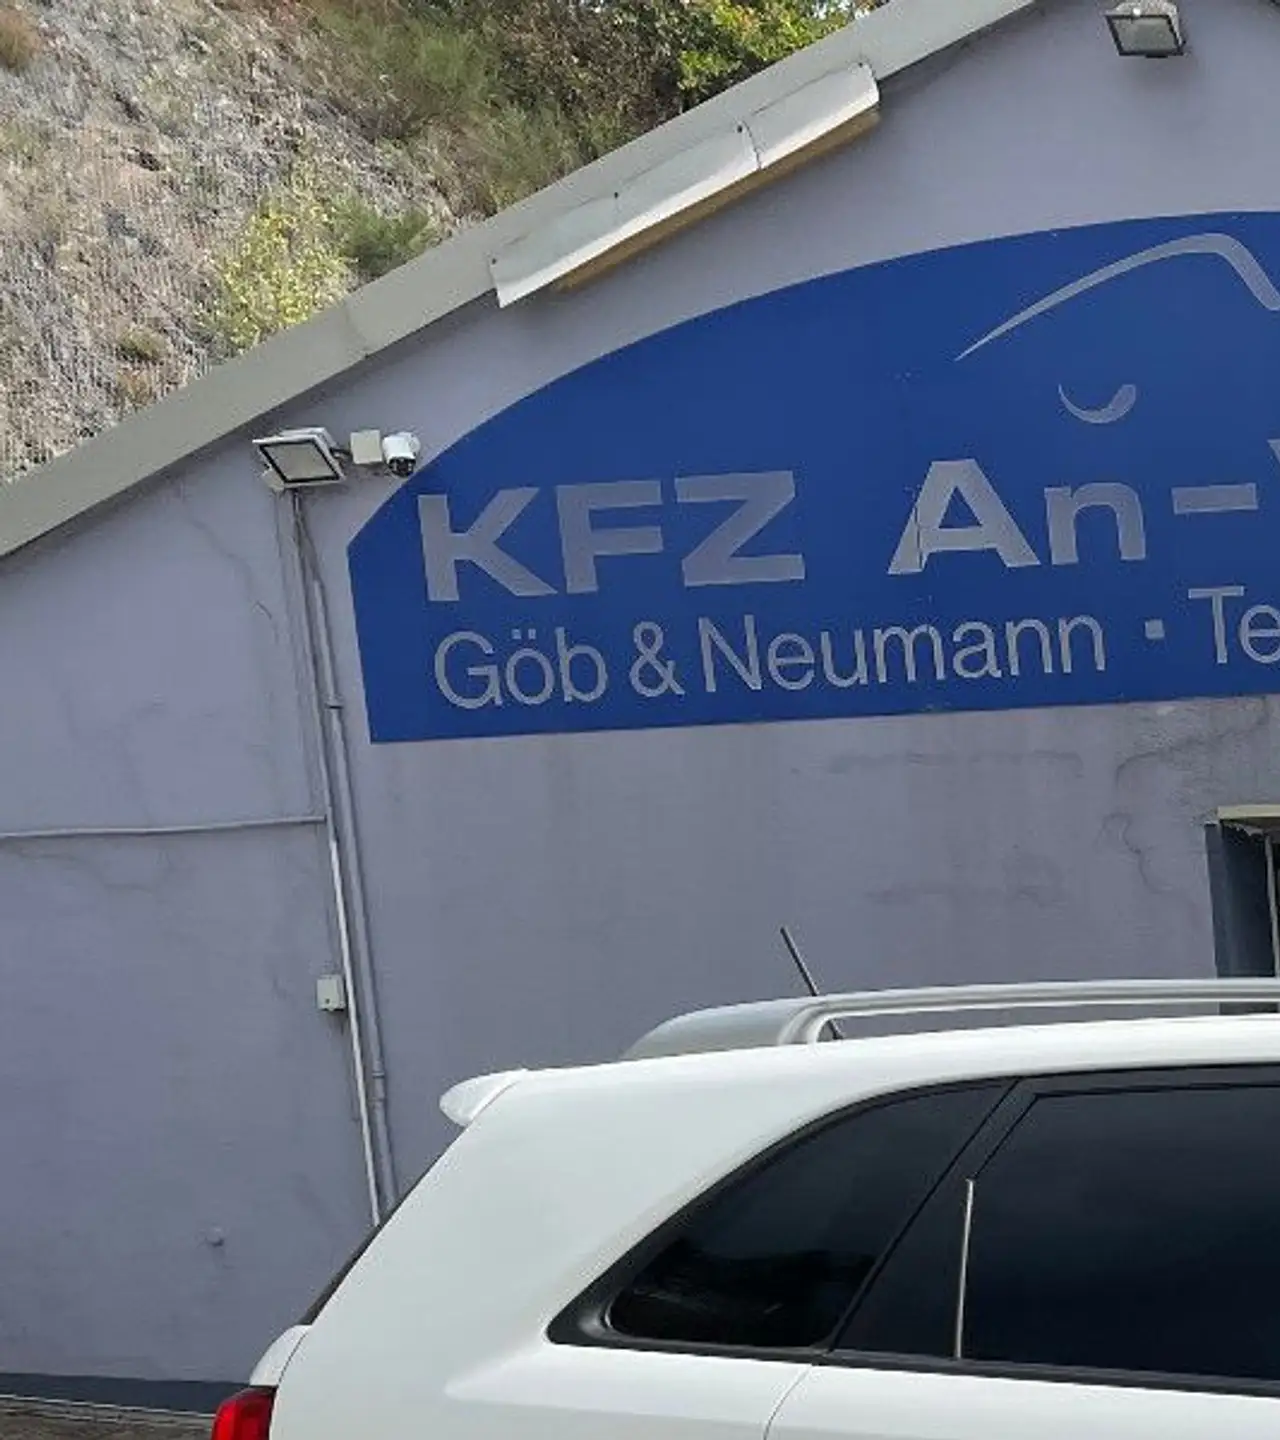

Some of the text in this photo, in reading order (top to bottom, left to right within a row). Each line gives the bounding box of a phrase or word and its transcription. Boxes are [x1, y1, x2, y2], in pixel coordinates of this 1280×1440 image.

[416, 470, 806, 602] KFZ
[433, 615, 608, 710] Göb
[628, 620, 686, 698] &
[698, 614, 1106, 693] Neumann
